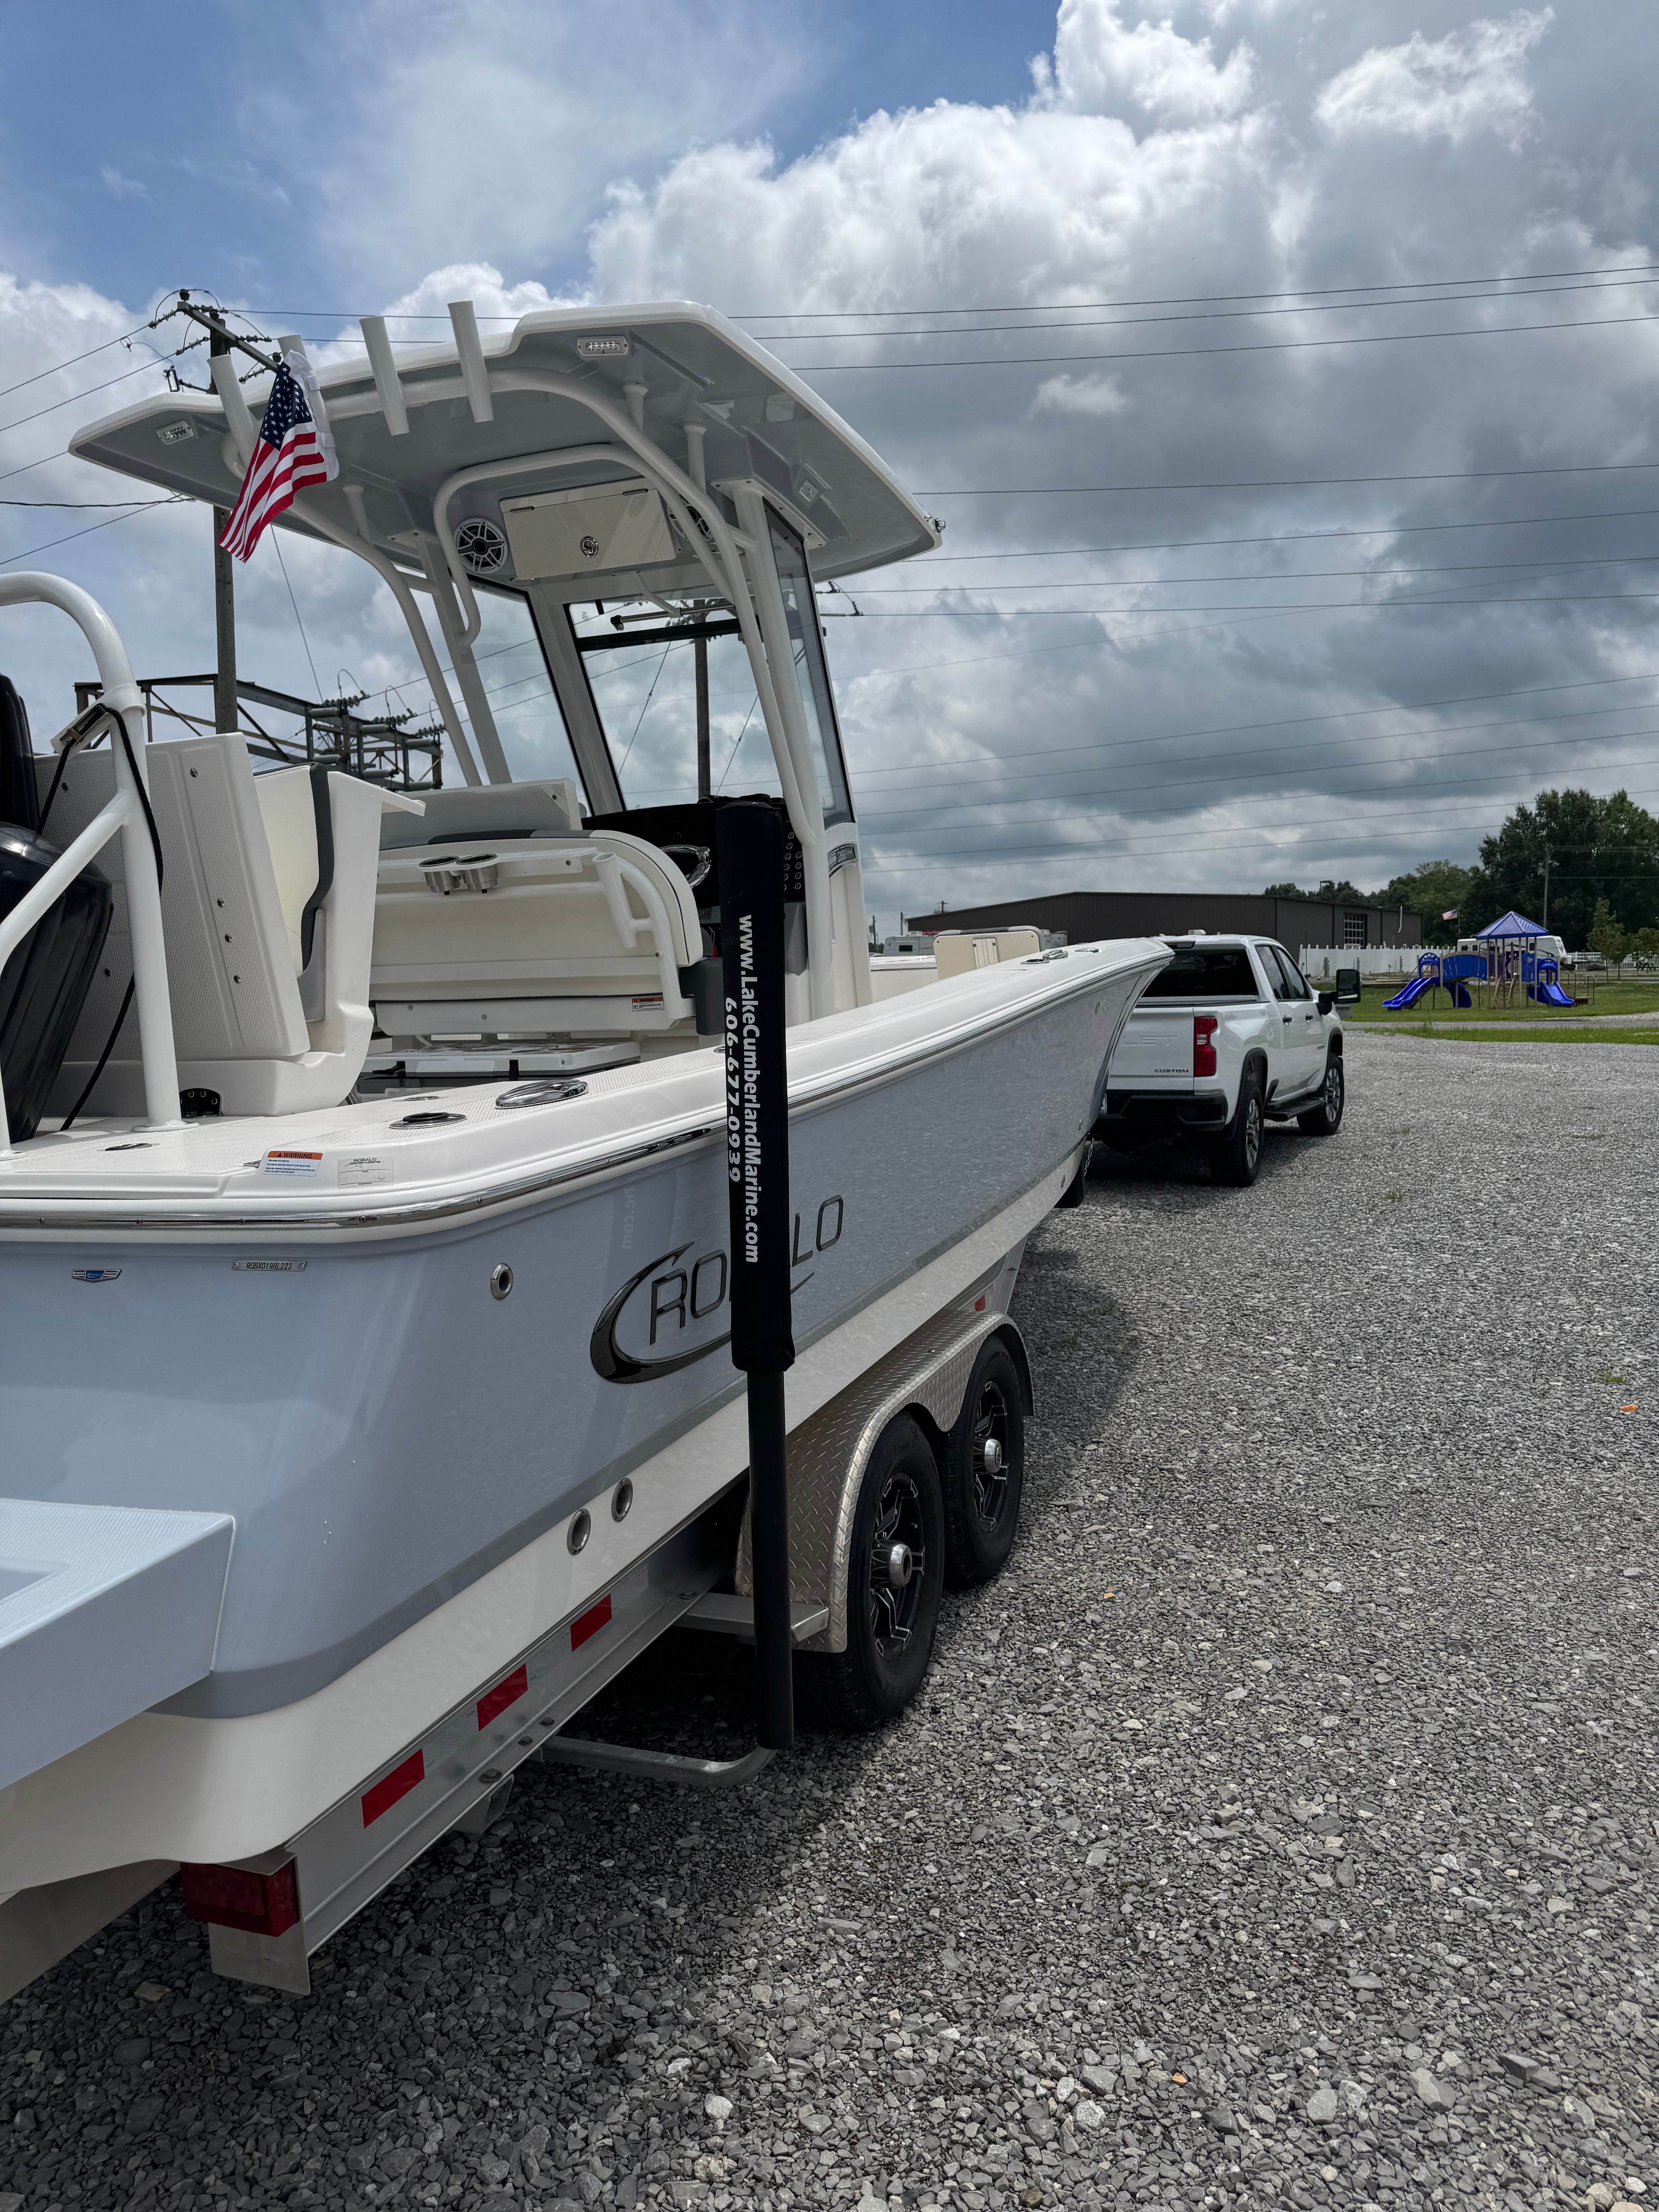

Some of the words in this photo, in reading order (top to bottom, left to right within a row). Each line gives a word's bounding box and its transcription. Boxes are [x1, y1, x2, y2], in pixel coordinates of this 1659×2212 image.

[725, 996, 740, 1182] 606-677-0939
[739, 914, 761, 1262] www.LakeCumberlandMarine.com
[649, 1195, 843, 1345] ROLO
